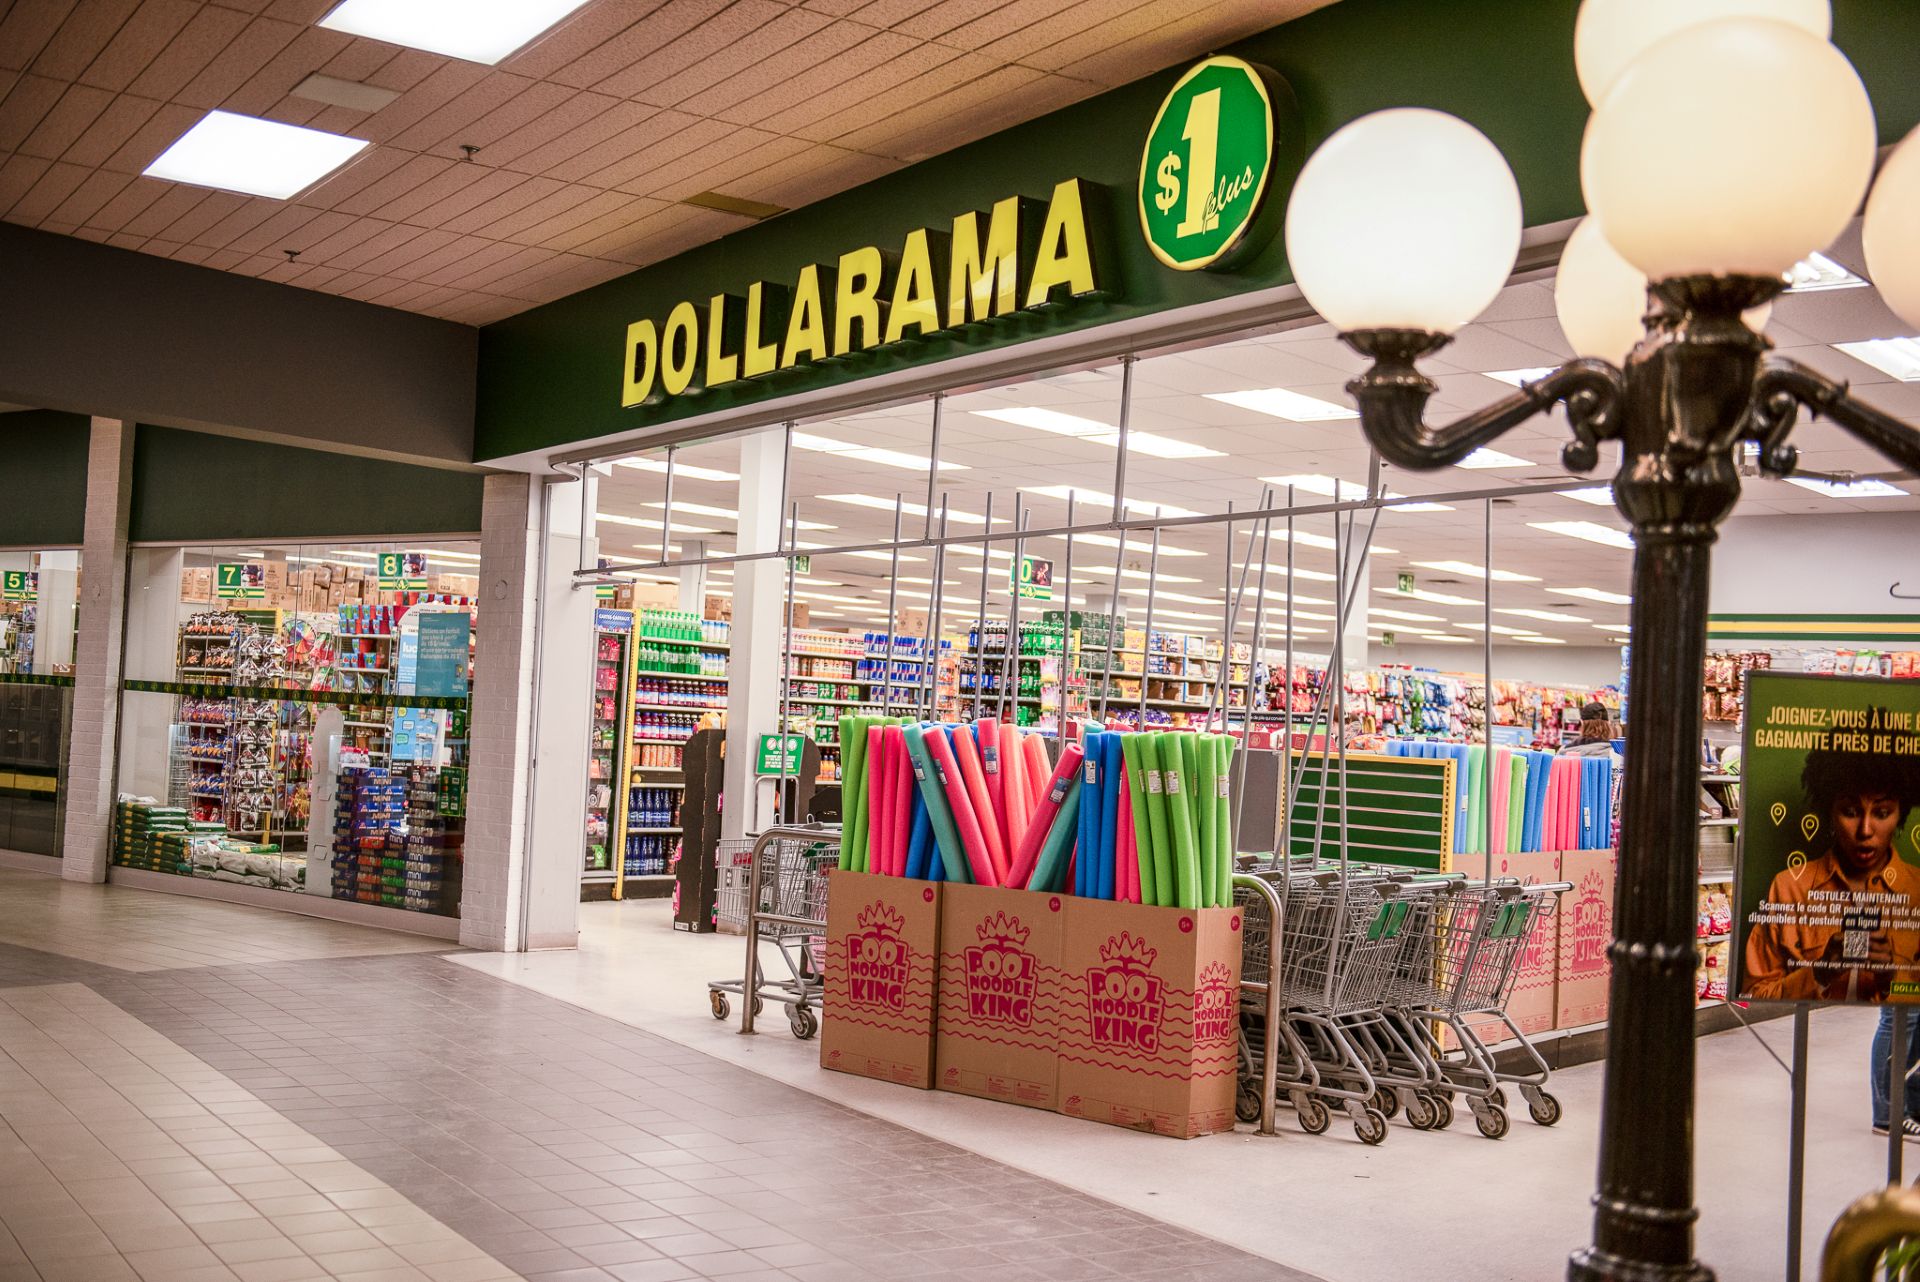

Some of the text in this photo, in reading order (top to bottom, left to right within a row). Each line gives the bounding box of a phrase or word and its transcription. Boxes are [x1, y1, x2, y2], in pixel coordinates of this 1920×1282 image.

[1202, 165, 1255, 235] plus
[621, 177, 1097, 408] DOLLARAMA
[223, 567, 236, 584] 7
[384, 556, 397, 575] 8
[8, 573, 20, 588] 5
[1766, 706, 1867, 729] JOIGNEZ-VOUS
[1870, 707, 1880, 729] À
[1884, 711, 1912, 730] UNE
[1755, 729, 1829, 751] GAGNANTE
[1833, 731, 1869, 753] PRÈS
[1873, 735, 1892, 753] DE
[408, 852, 423, 861] mini
[407, 871, 421, 880] mini
[1759, 899, 1795, 912] Scannez
[1797, 902, 1805, 912] le
[1806, 903, 1827, 913] code
[1829, 903, 1842, 914] QR
[1843, 907, 1863, 917] pour
[1864, 905, 1881, 915] voir
[1882, 906, 1890, 916] la
[1892, 906, 1909, 916] liste
[1807, 890, 1910, 905] POSTULEZ MAINTENANT!
[1575, 902, 1603, 925] POOL
[1748, 911, 1797, 925] disponibles
[1799, 914, 1808, 924] et
[1809, 915, 1844, 927] postuler
[1845, 918, 1857, 927] en
[1858, 916, 1878, 929] ligne
[1880, 918, 1891, 928] en
[1575, 926, 1603, 938] NOODLE
[850, 937, 906, 968] POOL
[1575, 939, 1602, 962] KING
[850, 962, 906, 983] NOODLE
[968, 949, 1034, 980] POOL
[851, 978, 902, 1008] KING
[969, 976, 1033, 997] NOODLE
[1091, 971, 1161, 1005] POOL
[971, 992, 1029, 1023] KING
[1194, 989, 1232, 1010] POOL
[1092, 998, 1160, 1023] NOODLE
[1194, 1009, 1232, 1021] NOODLE
[1093, 1016, 1155, 1050] KING
[1195, 1021, 1229, 1040] KING
